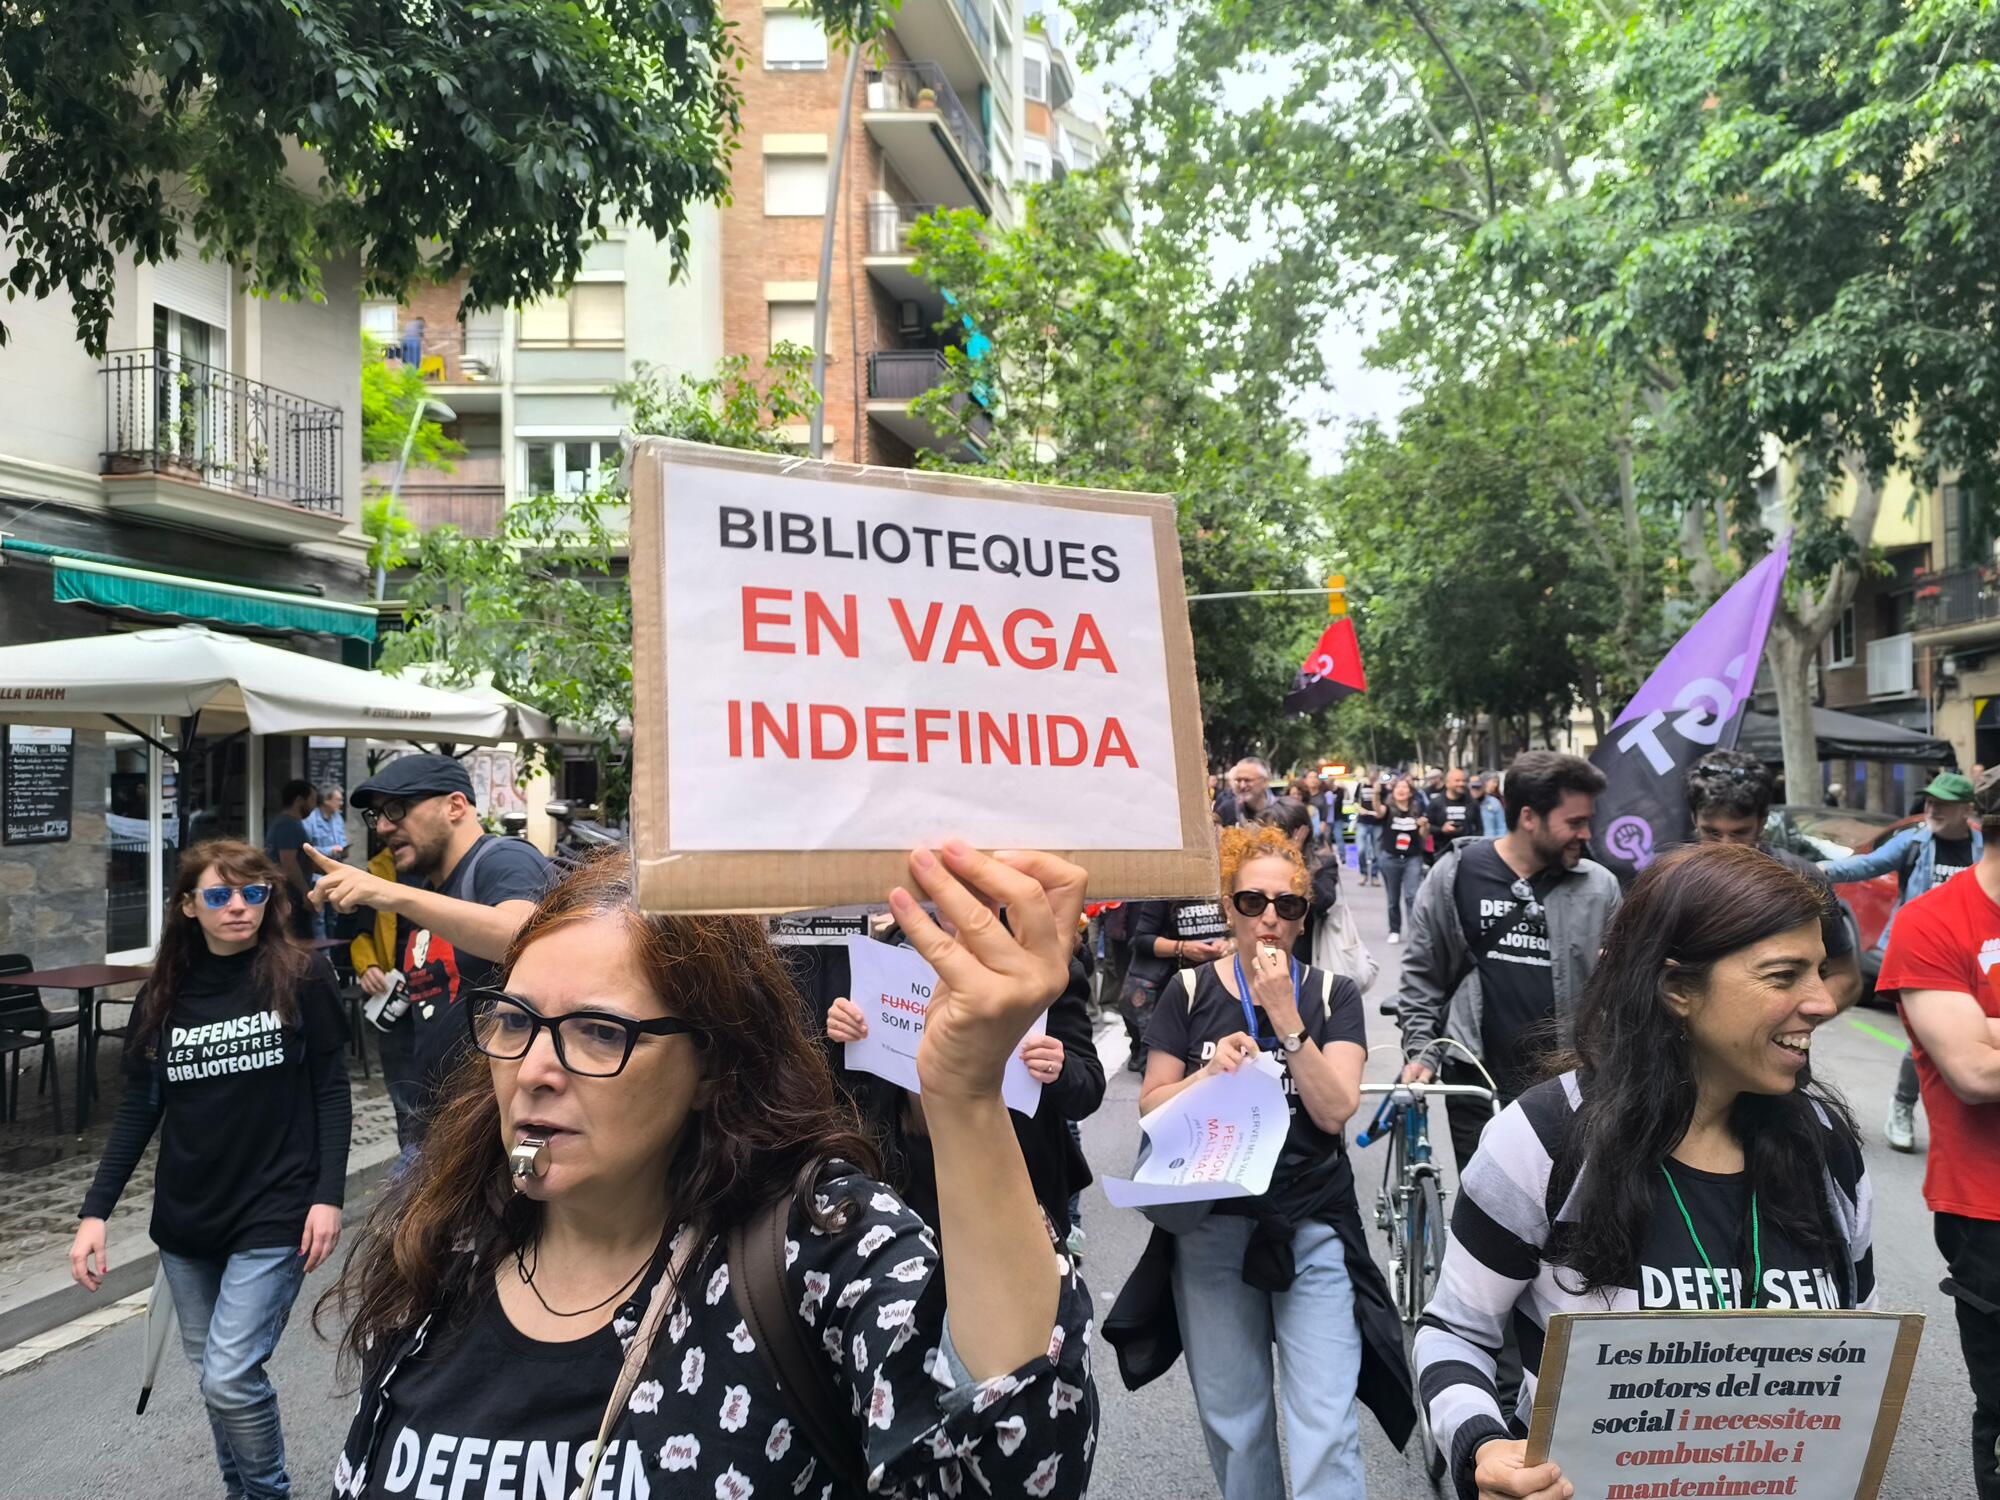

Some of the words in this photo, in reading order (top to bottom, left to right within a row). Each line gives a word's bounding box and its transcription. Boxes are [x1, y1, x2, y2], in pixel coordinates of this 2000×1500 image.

[719, 505, 1121, 584] BIBLIOTEQUES
[741, 585, 860, 659] EN
[887, 597, 1118, 674] VAGA
[26, 687, 66, 701] DAMM
[727, 699, 1140, 769] INDEFINIDA
[779, 927, 813, 935] VAGA
[814, 926, 861, 935] BIBLIOS
[911, 982, 931, 998] NO
[881, 993, 928, 1016] FUNCI
[171, 1009, 282, 1047] DEFENSEM
[881, 1011, 910, 1031] SOM
[914, 1022, 926, 1034] P
[167, 1049, 194, 1063] LES
[202, 1032, 283, 1058] NOSTRES
[167, 1047, 285, 1082] BIBLIOTEQUES
[1596, 1343, 1643, 1366] Les
[1646, 1341, 1813, 1368] biblioteques
[1817, 1340, 1866, 1364] són
[1608, 1377, 1711, 1400] motors
[1715, 1373, 1761, 1397] del
[1764, 1374, 1842, 1397] canvi
[1591, 1409, 1676, 1434] social
[1678, 1409, 1690, 1431] i
[1693, 1407, 1841, 1431] necessiten
[1615, 1440, 1788, 1467] combustible
[1791, 1441, 1805, 1463] i
[1605, 1474, 1799, 1500] manteniment
